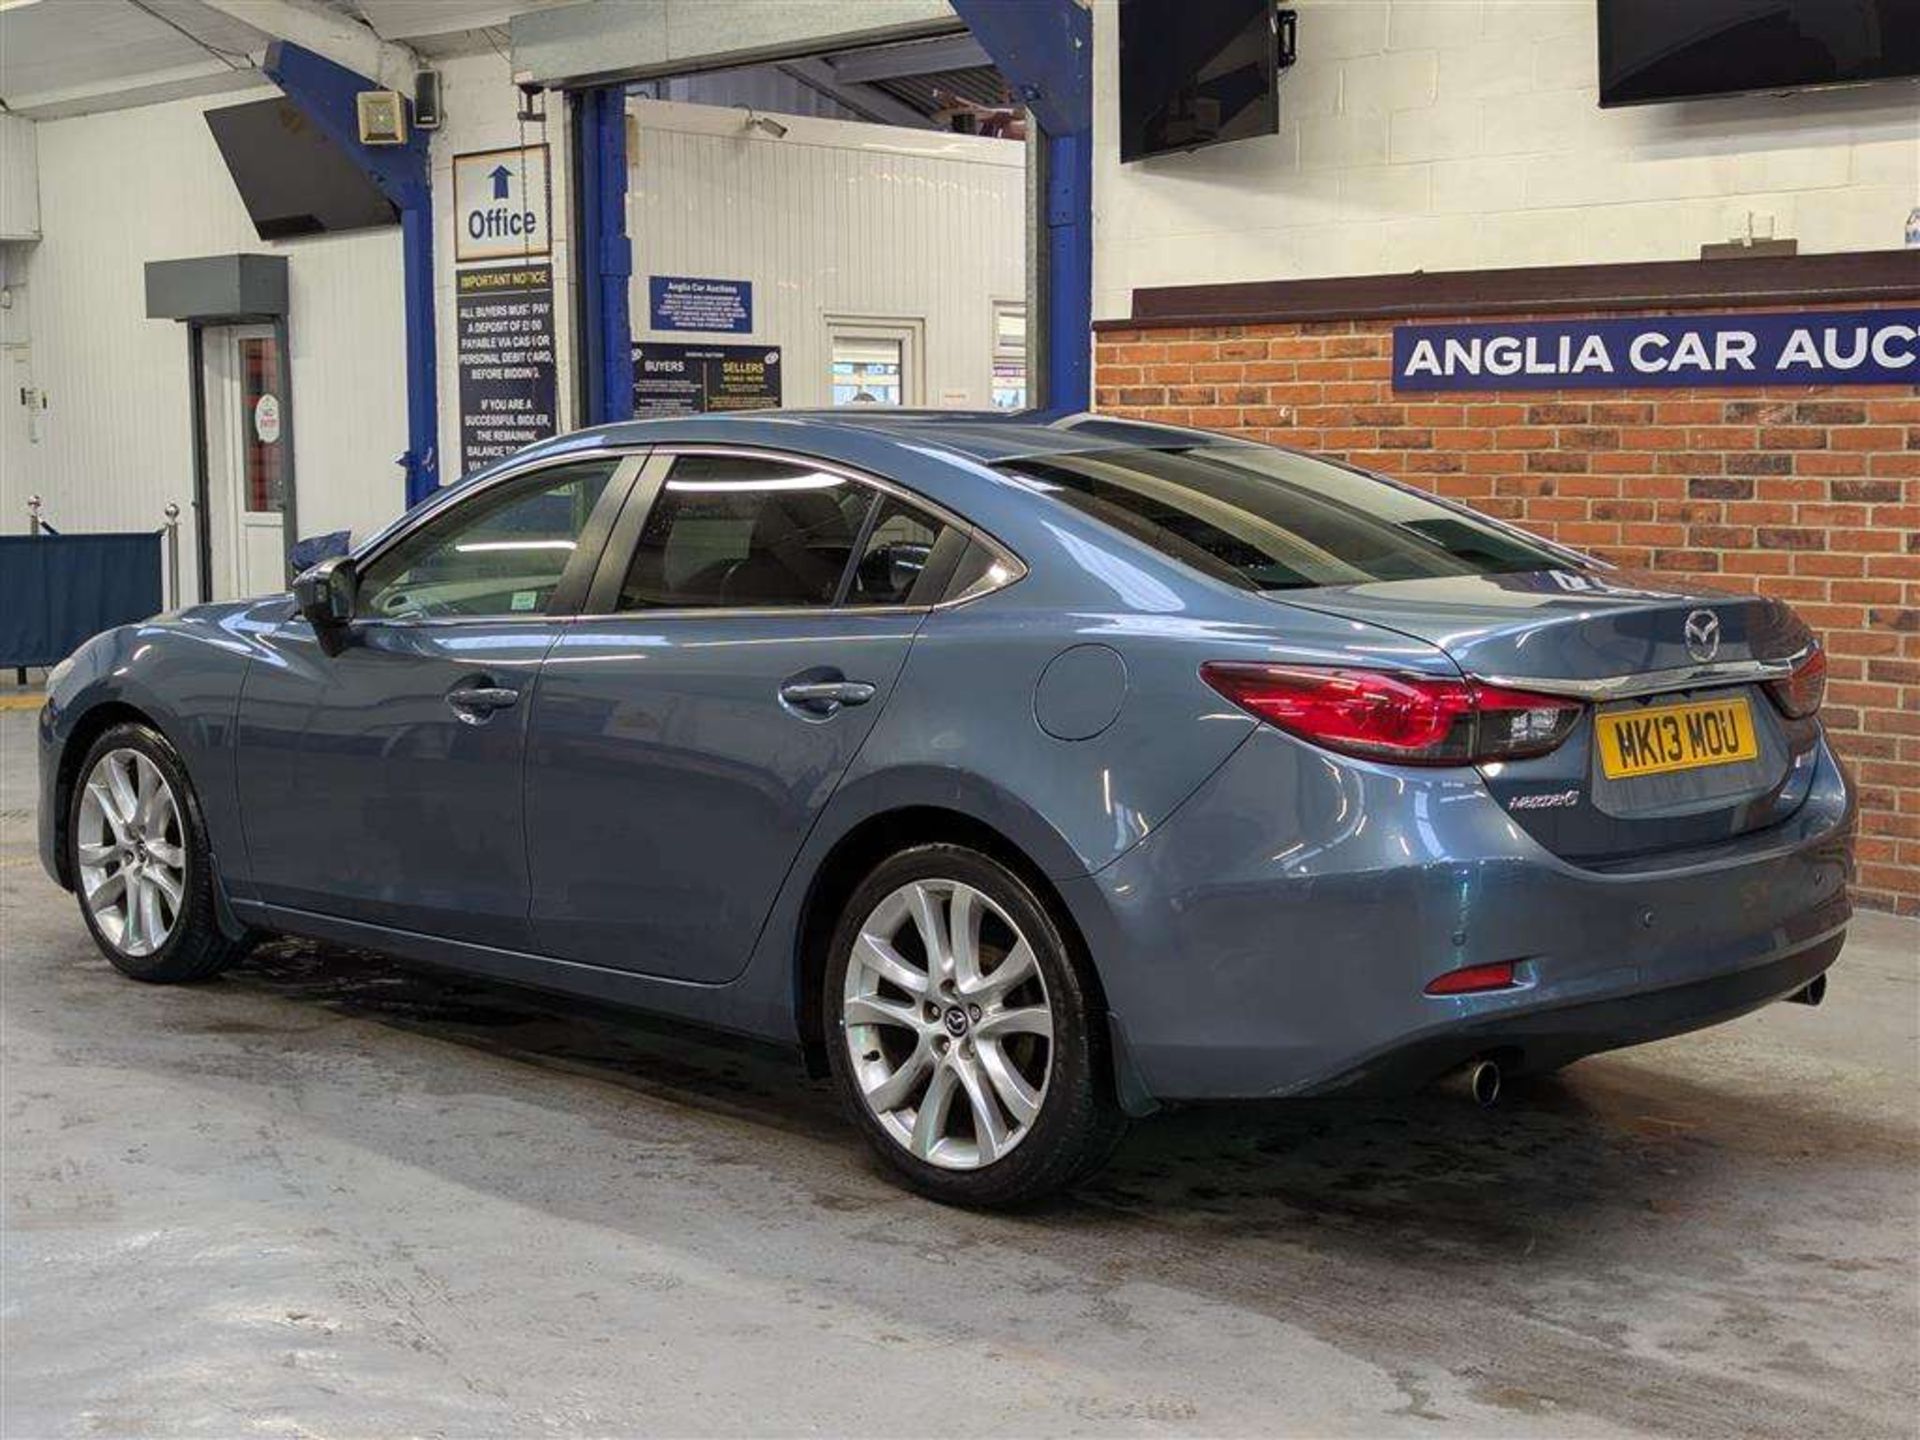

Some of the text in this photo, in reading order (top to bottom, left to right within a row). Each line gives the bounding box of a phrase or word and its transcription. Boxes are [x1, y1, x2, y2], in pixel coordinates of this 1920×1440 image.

[468, 207, 536, 239] Office
[461, 270, 547, 288] IMPORTANT NOICE
[475, 305, 507, 317] BUYERS
[532, 303, 550, 315] PAY
[474, 321, 508, 333] DEPOSIT
[510, 320, 521, 332] OF
[461, 337, 497, 349] PAYABLE
[498, 336, 512, 348] VIA
[537, 335, 550, 346] OR
[1404, 325, 1920, 376] ANGLIA CAR AUC
[460, 352, 500, 364] PERSONAL
[501, 352, 525, 363] DEBIT
[644, 360, 685, 372] BUYERS
[722, 362, 765, 373] SELLERS
[471, 368, 502, 379] BEFORE
[490, 399, 506, 410] YOU
[508, 399, 525, 410] ARE
[526, 398, 533, 409] A
[464, 414, 516, 426] SUCCESSFUL
[477, 430, 492, 441] THE
[466, 445, 505, 457] BALANCE
[1615, 709, 1739, 769] MK13 MOU
